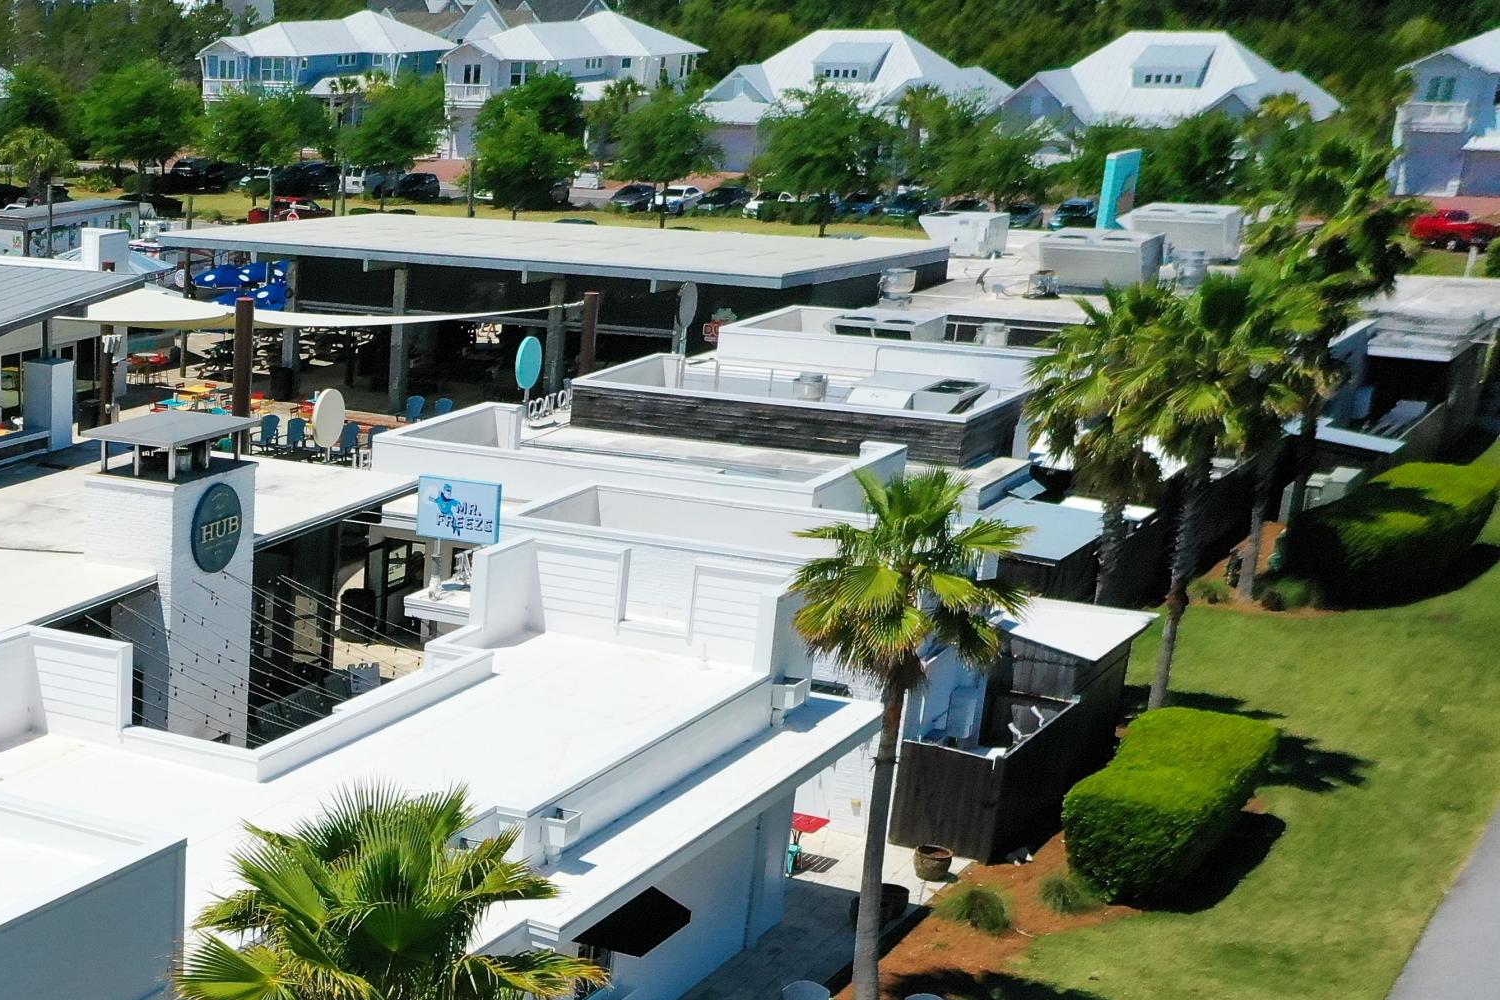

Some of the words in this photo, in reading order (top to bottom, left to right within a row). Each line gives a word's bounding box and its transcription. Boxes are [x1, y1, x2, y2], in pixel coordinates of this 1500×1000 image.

[456, 502, 482, 517] MR.
[201, 515, 239, 544] HUB
[436, 514, 493, 533] FREEZE
